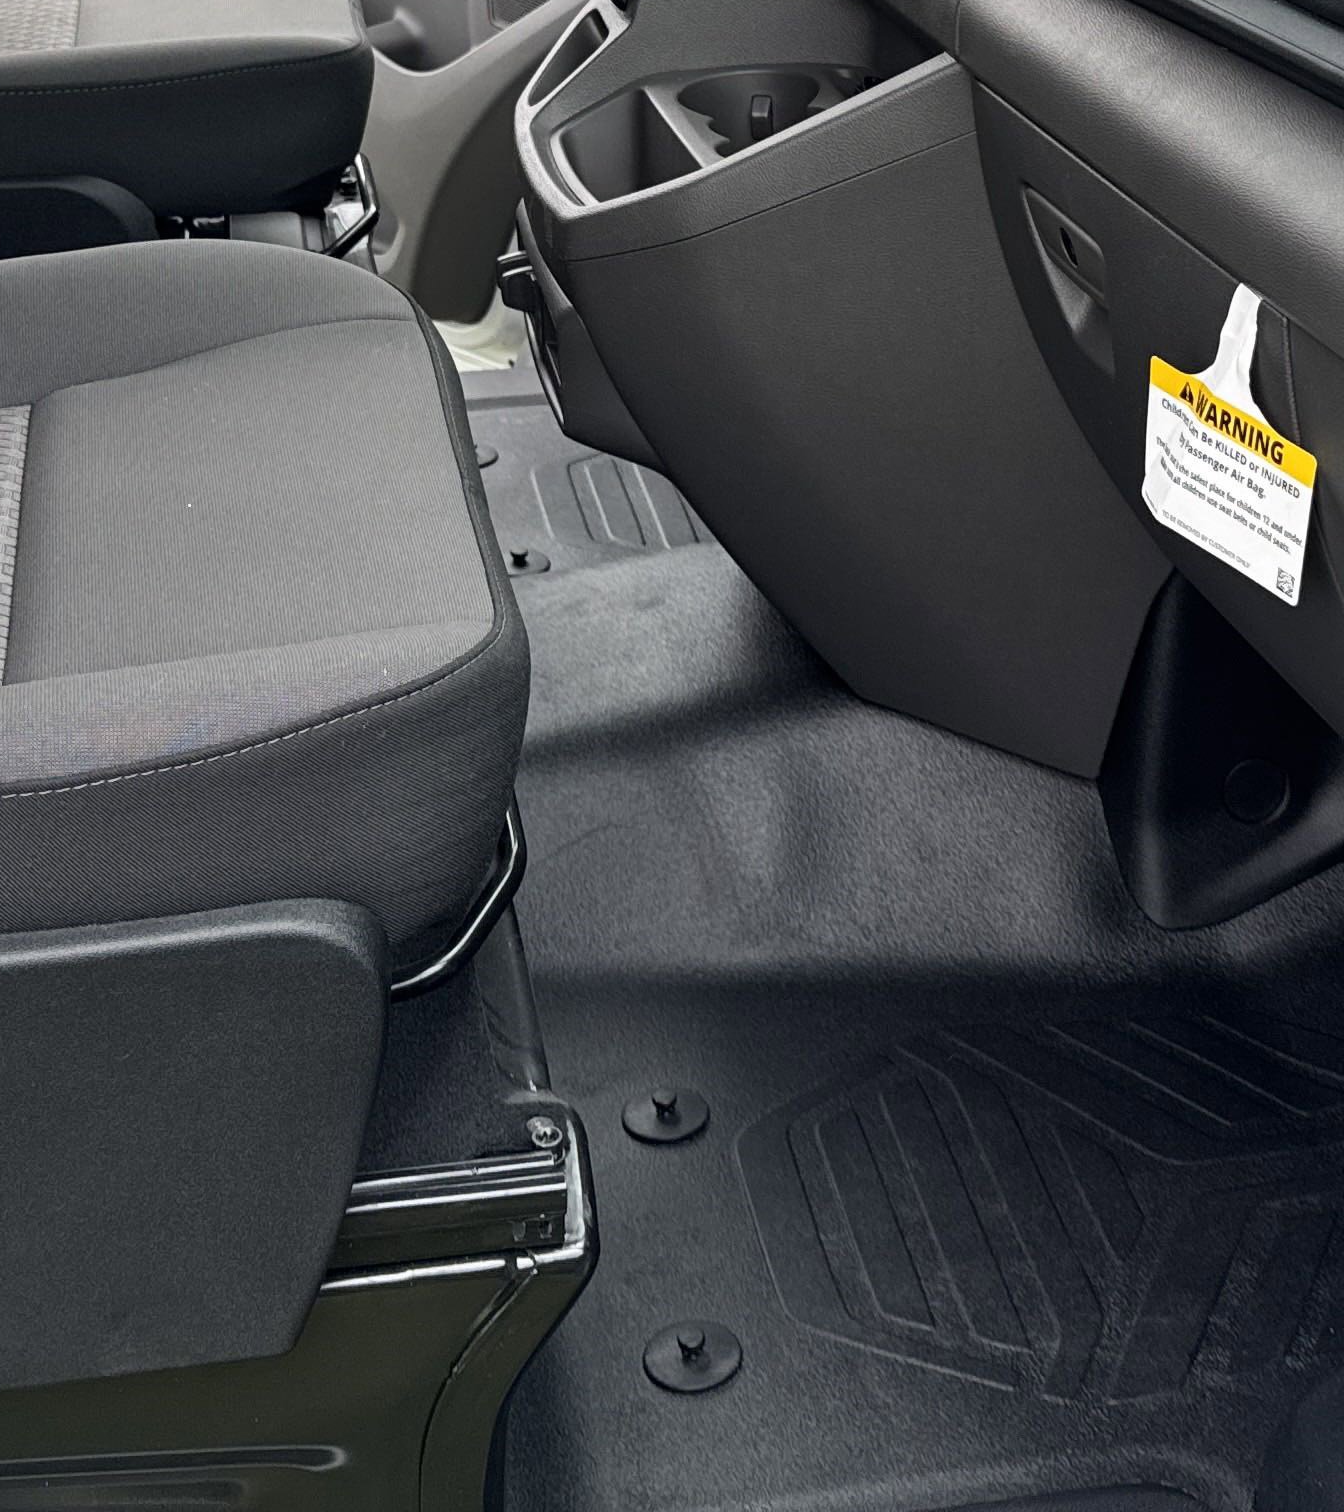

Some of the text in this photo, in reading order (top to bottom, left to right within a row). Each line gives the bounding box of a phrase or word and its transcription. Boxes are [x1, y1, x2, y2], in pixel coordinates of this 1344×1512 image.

[1195, 388, 1284, 465] WARNING
[1201, 431, 1213, 447] Be
[1215, 439, 1247, 465] KILLED
[1249, 462, 1259, 473] or
[1261, 467, 1300, 499] INJURED
[1230, 469, 1245, 484] Air
[1181, 480, 1206, 501] children
[1256, 526, 1272, 542] child
[1236, 499, 1261, 520] children
[1263, 514, 1271, 526] 12
[1271, 521, 1284, 535] and
